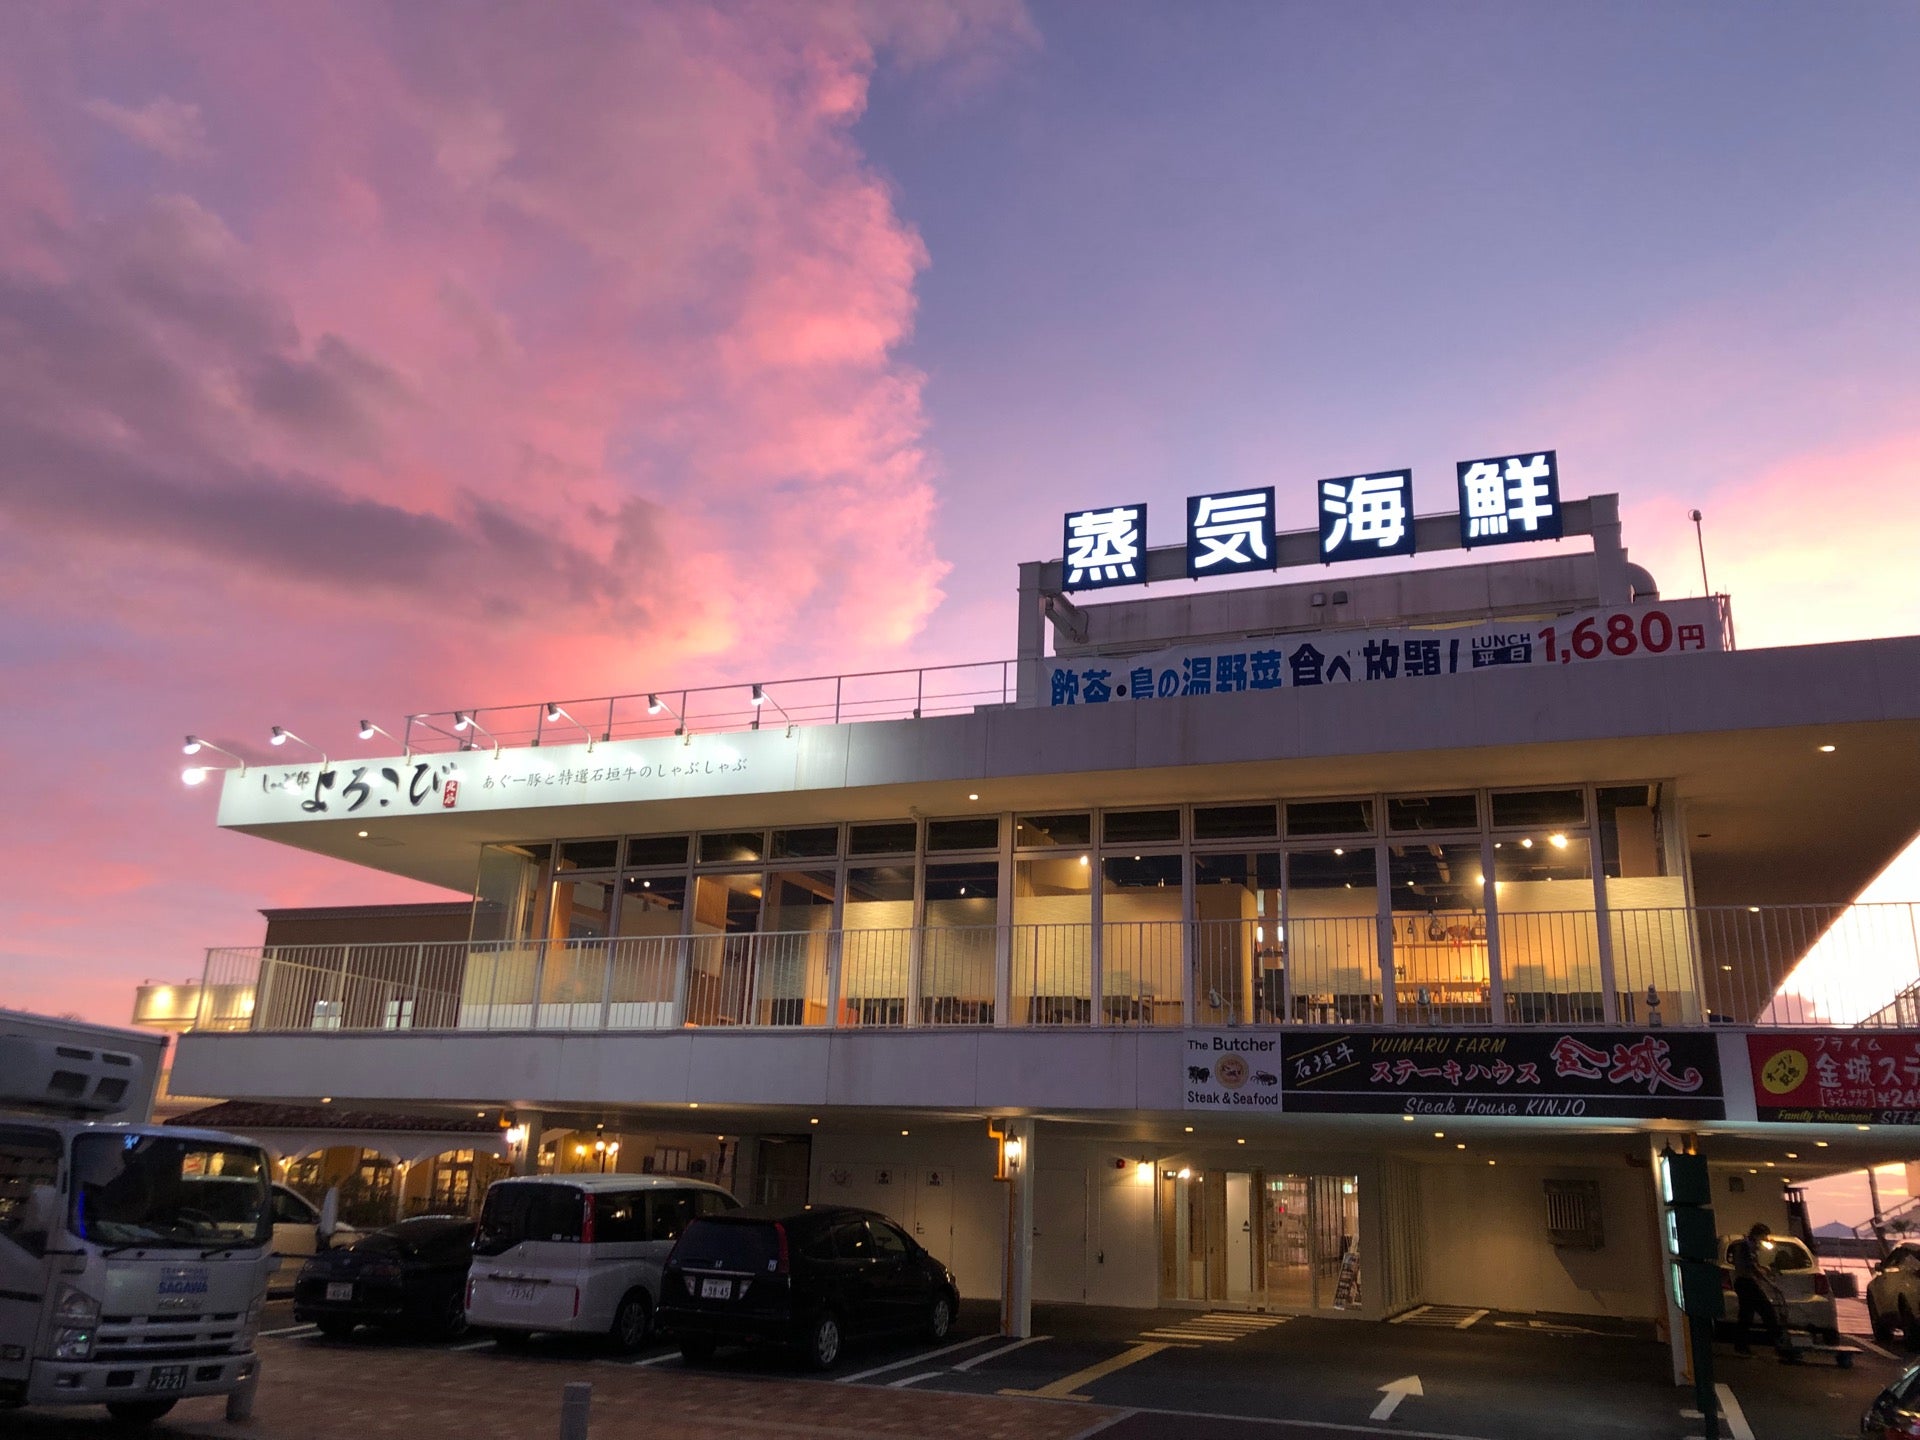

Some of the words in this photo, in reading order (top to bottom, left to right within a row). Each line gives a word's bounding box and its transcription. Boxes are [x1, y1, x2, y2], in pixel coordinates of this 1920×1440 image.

[1067, 454, 1553, 583] 蒸気海鮮
[1472, 633, 1531, 649] LUNCH
[1538, 611, 1706, 664] 1,680円
[1478, 646, 1526, 664] 平日
[1187, 1040, 1209, 1050] The
[1213, 1037, 1276, 1051] Butcher
[1370, 1037, 1450, 1053] YUIMARU
[1455, 1037, 1507, 1053] FARM
[1814, 1036, 1882, 1052] プライム
[1294, 1042, 1354, 1079] 石垣牛
[1550, 1035, 1704, 1094] 金城
[1370, 1058, 1541, 1086] ステーキハウス
[1187, 1091, 1220, 1104] Steak
[1222, 1094, 1231, 1104] &
[1233, 1092, 1279, 1106] Seafood
[1404, 1097, 1457, 1114] Steak
[1464, 1098, 1518, 1115] House
[1525, 1098, 1586, 1116] KINJO
[1778, 1109, 1813, 1121] Family
[1817, 1110, 1873, 1122] Restaurant
[158, 1281, 208, 1294] SAGAWA
